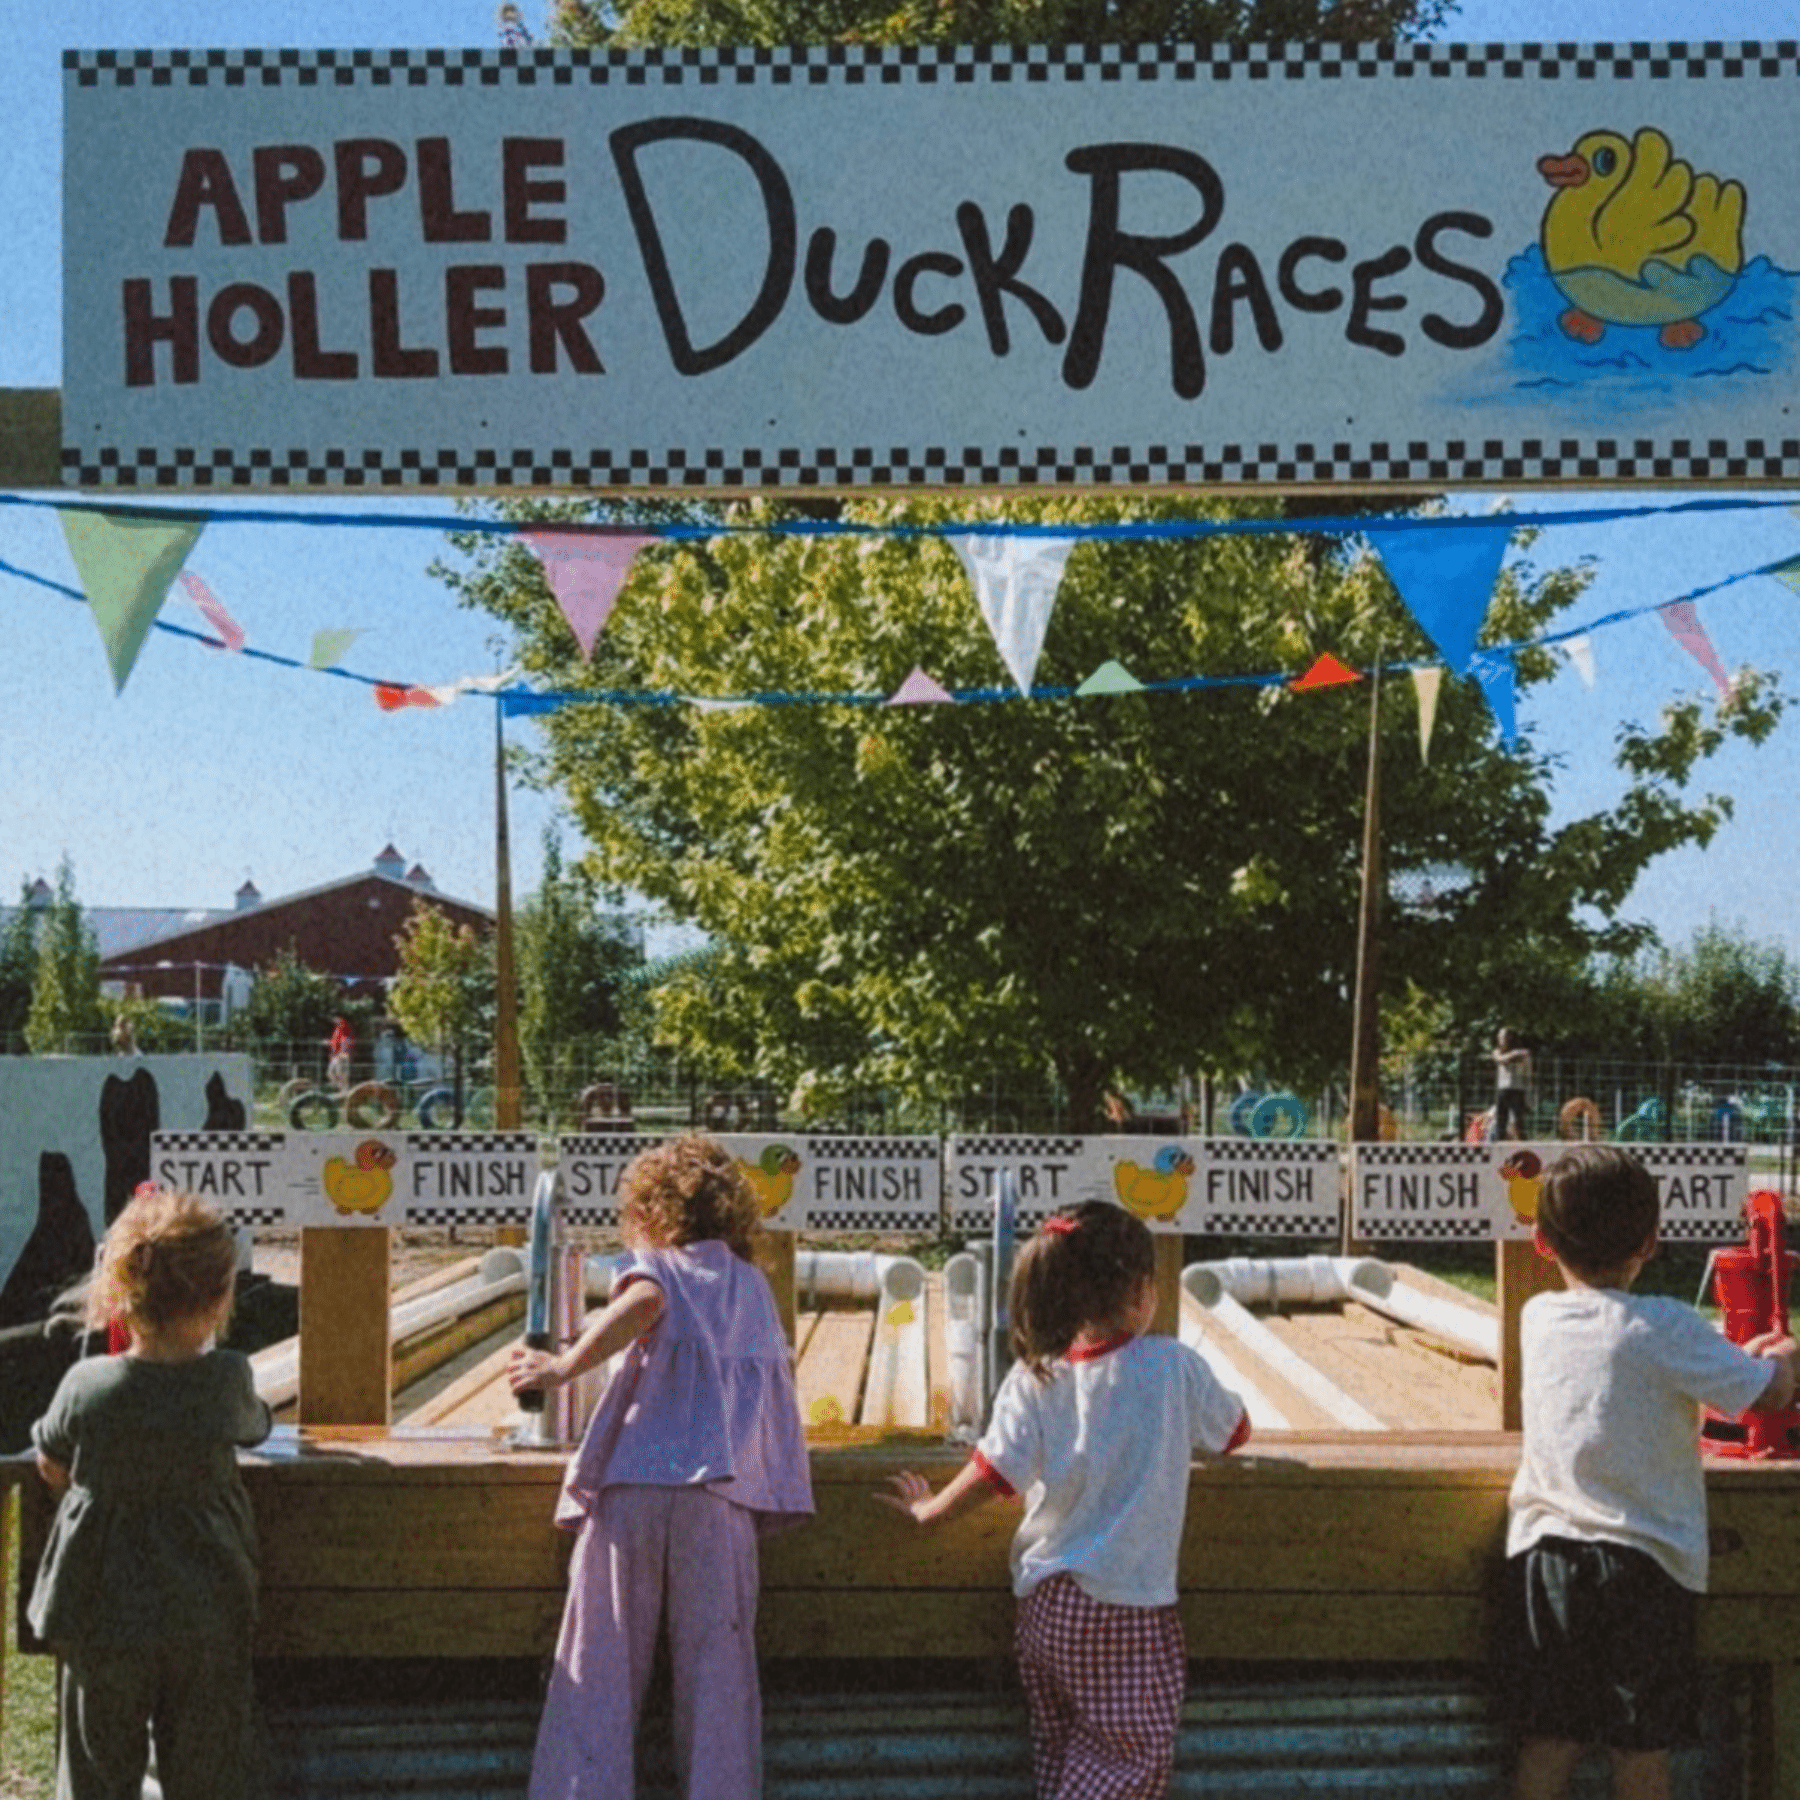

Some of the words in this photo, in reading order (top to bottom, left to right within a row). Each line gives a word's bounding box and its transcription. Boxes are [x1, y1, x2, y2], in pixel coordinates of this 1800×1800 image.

[164, 136, 568, 247] APPLE
[609, 116, 1066, 376] DUCK
[1062, 143, 1504, 399] RACES
[122, 262, 606, 387] HOLLER
[159, 1159, 271, 1196] START
[413, 1160, 525, 1197] FINISH
[815, 1166, 922, 1201] FINISH
[1207, 1168, 1313, 1203] FINISH
[1364, 1173, 1479, 1210] FINISH
